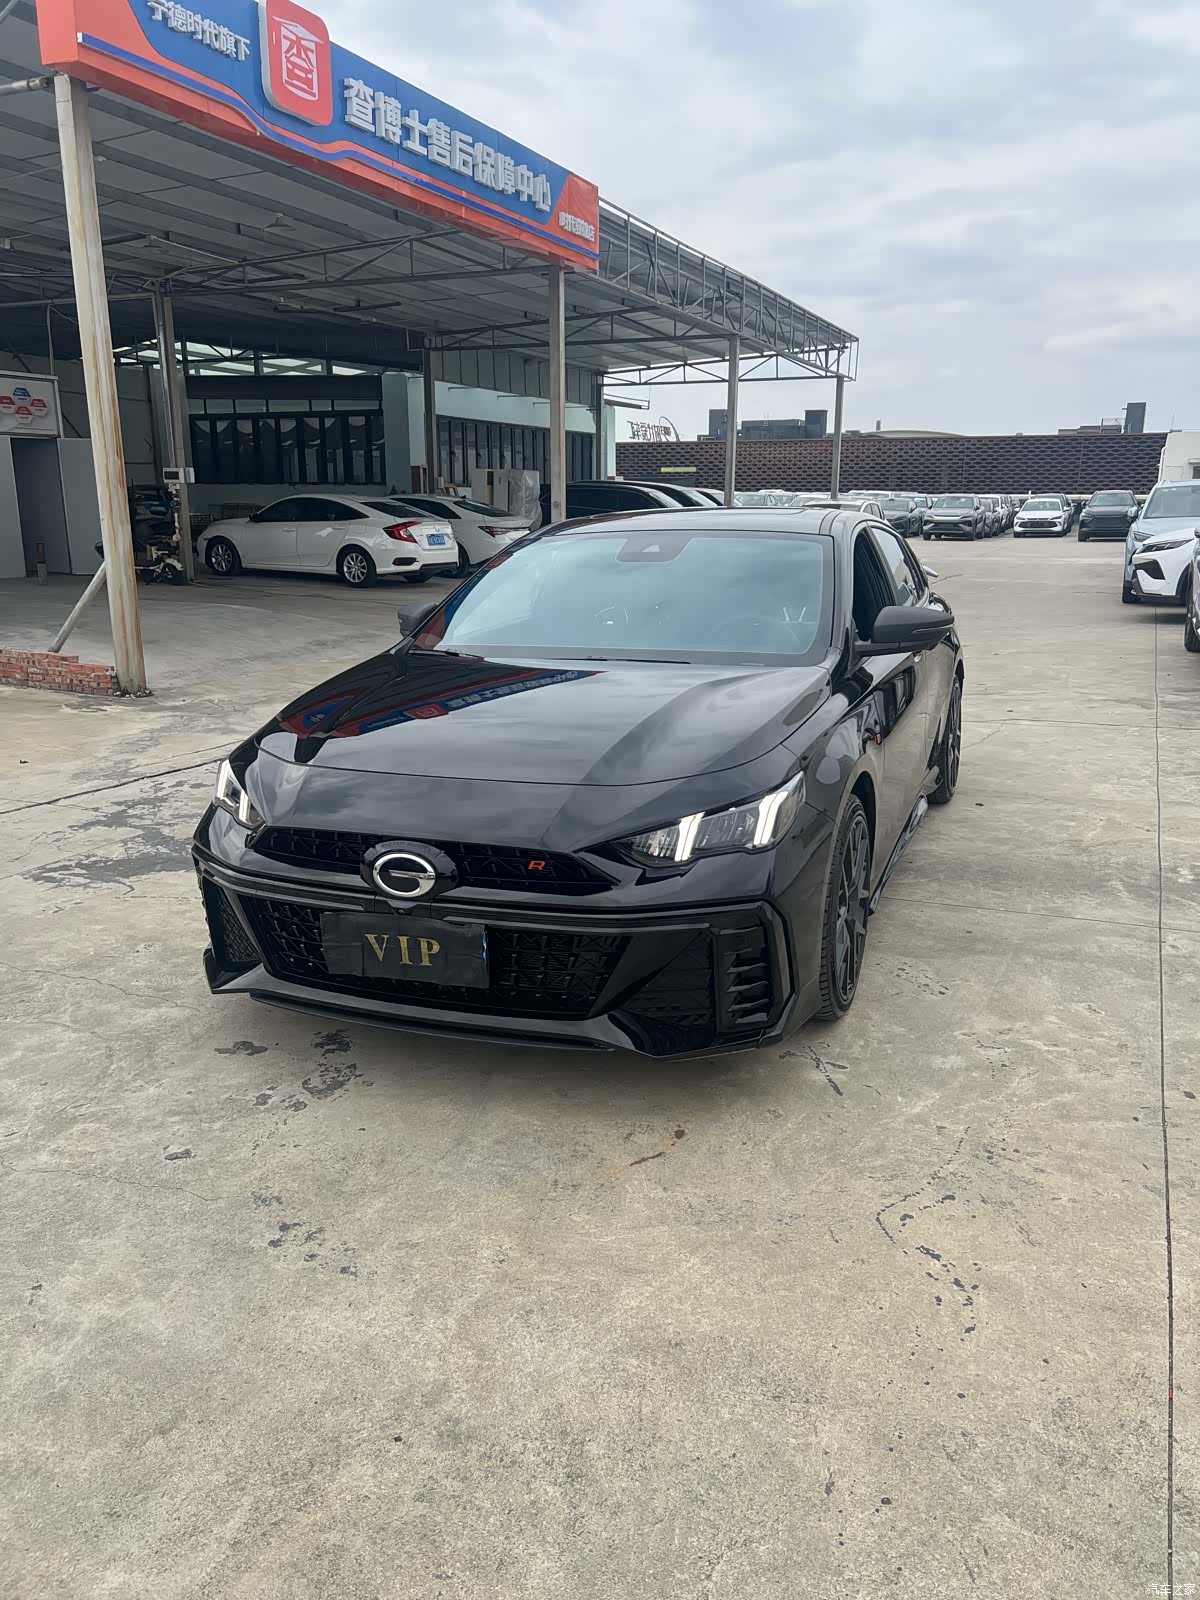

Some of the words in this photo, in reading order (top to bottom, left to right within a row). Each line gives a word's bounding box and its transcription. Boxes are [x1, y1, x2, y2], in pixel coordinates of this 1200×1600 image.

[147, 0, 250, 61] 宁德时代旗下
[343, 77, 551, 212] 查博士售后保障中心
[528, 860, 545, 871] R
[364, 933, 441, 966] VIP
